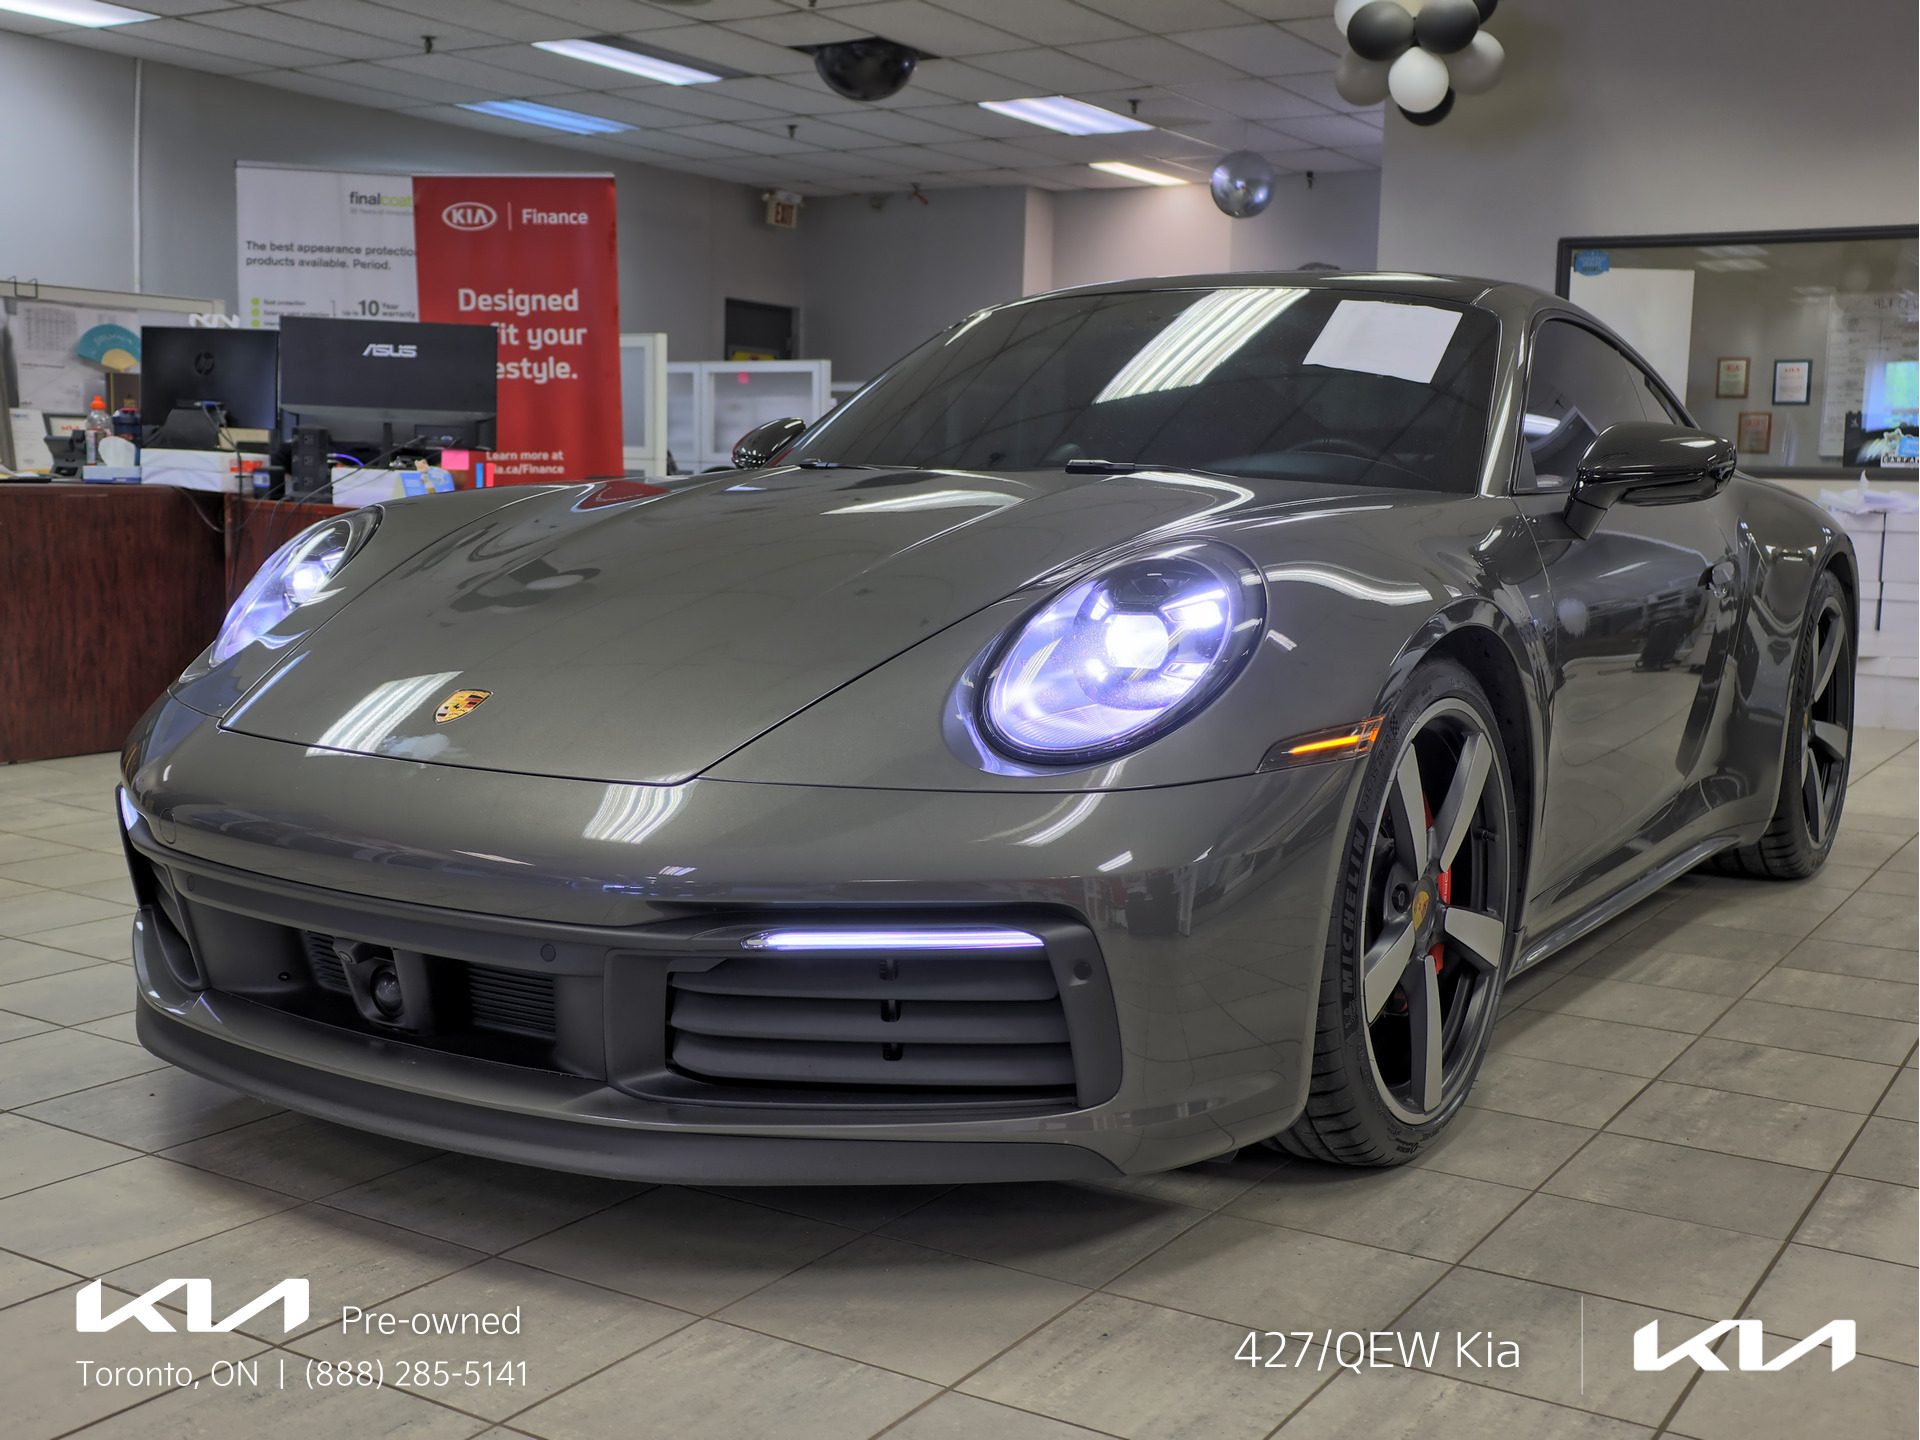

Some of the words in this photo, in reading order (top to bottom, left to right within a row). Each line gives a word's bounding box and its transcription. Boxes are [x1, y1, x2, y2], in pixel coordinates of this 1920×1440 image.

[349, 191, 413, 208] finalcoat
[522, 208, 589, 225] Finance
[246, 240, 267, 251] The
[270, 241, 294, 252] best
[297, 244, 362, 255] appearance
[365, 246, 417, 257] protectio
[246, 256, 295, 267] products
[298, 257, 350, 269] available.
[353, 258, 392, 271] Period.
[358, 300, 380, 317] 10
[458, 287, 579, 317] Designed
[526, 327, 588, 351] your
[362, 343, 417, 358] ASUS
[496, 356, 578, 384] estyle.
[486, 450, 518, 461] Learn
[520, 451, 549, 461] more
[551, 450, 564, 461] at
[494, 462, 565, 475] ia.ca/Finance
[1342, 828, 1367, 994] MICHELIN
